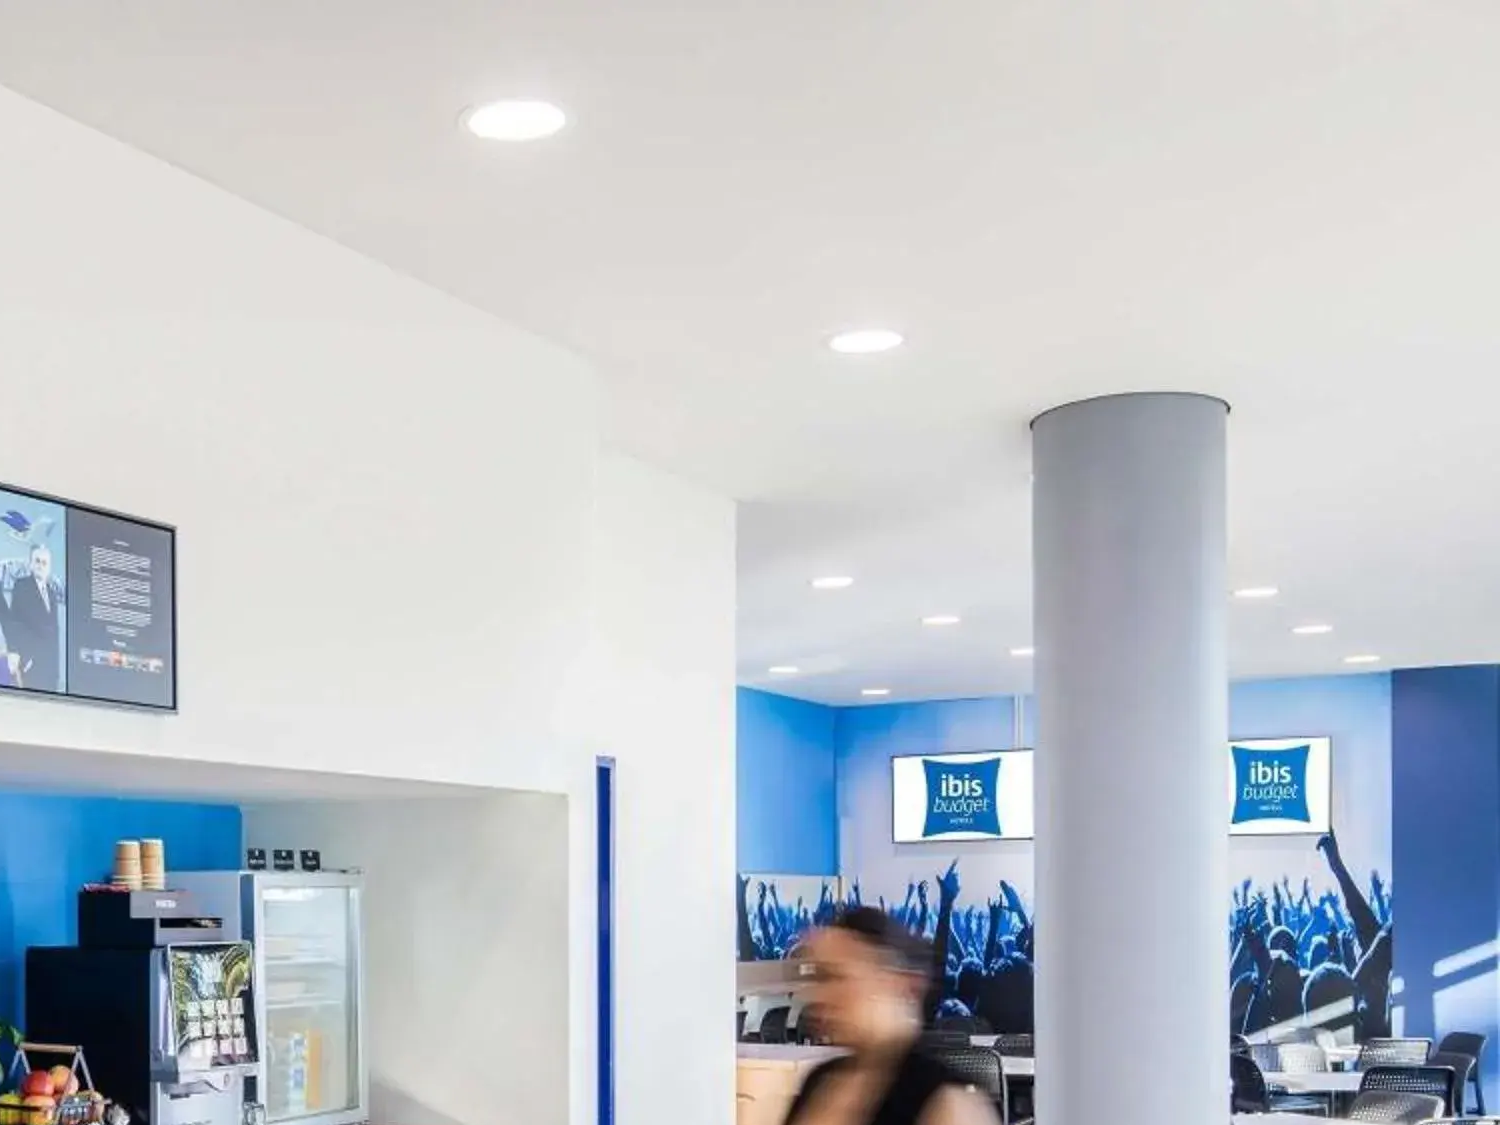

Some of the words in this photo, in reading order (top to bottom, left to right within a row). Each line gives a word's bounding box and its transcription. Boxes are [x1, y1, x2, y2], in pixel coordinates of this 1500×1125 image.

[1250, 760, 1292, 784] ibis
[941, 773, 983, 797] ibis
[1242, 783, 1299, 803] budget
[933, 796, 990, 817] budget
